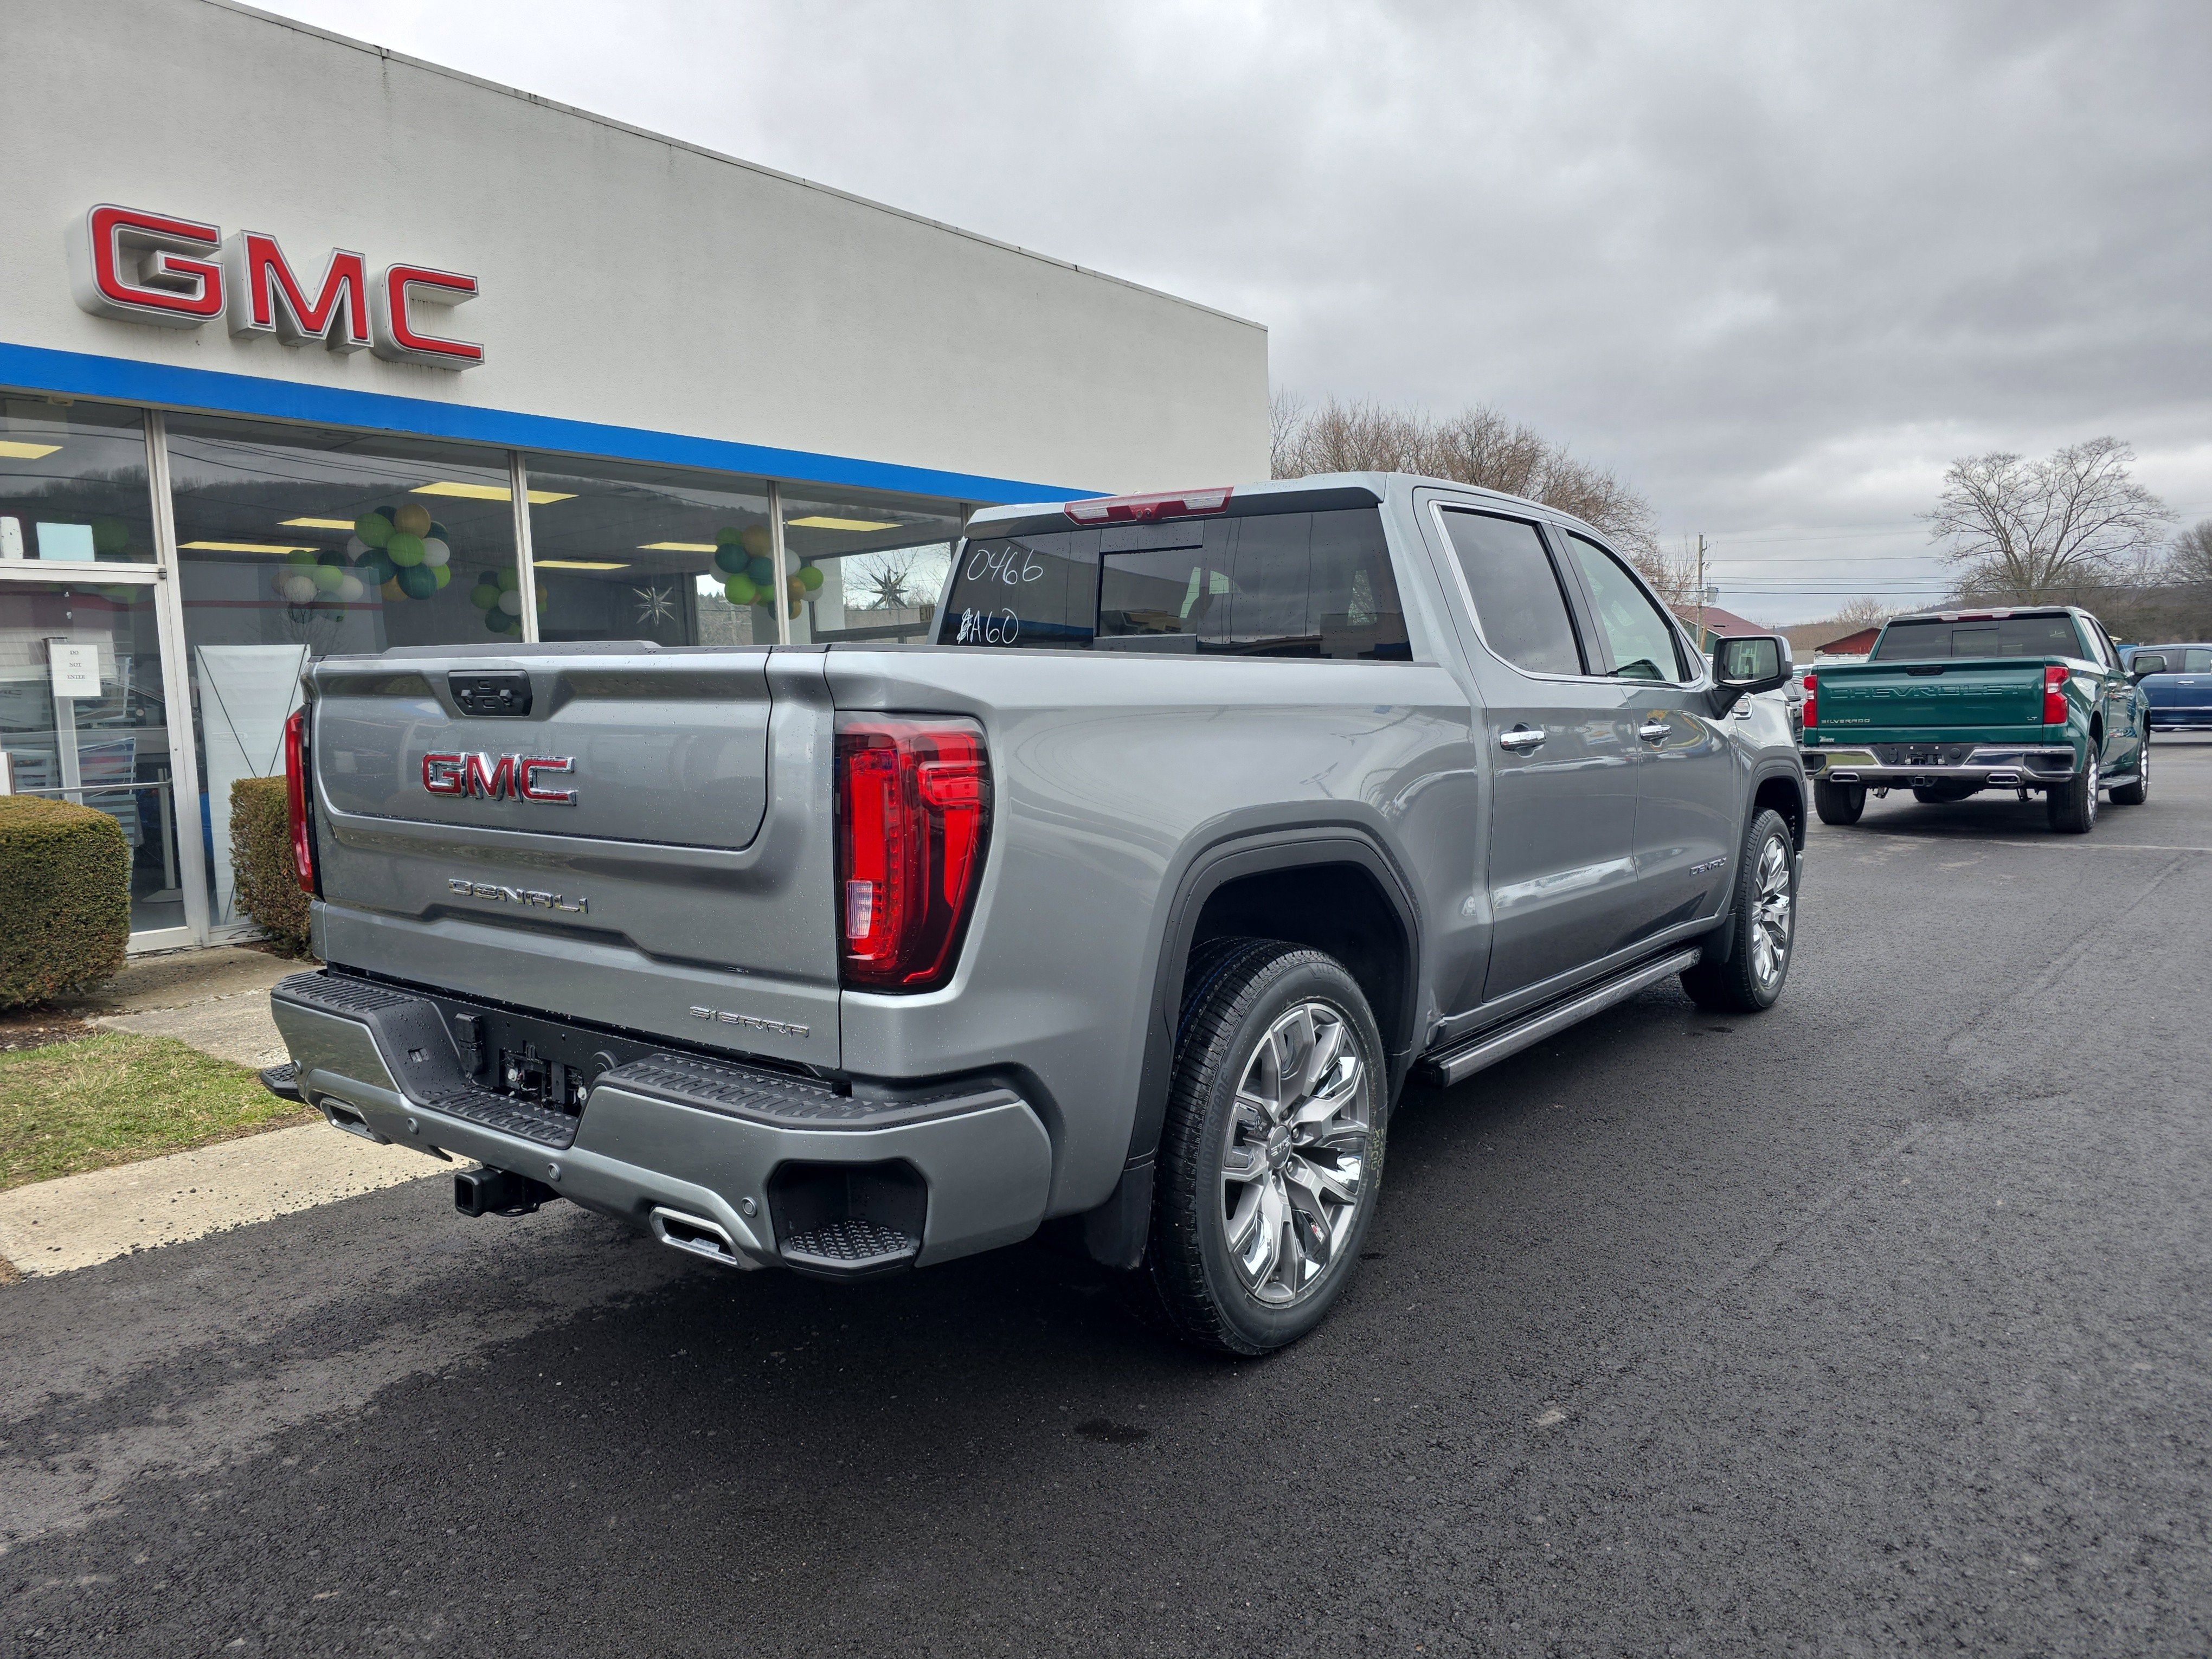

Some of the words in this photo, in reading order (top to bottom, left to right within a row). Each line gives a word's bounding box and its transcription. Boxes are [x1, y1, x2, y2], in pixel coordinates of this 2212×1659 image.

[86, 203, 485, 366] GMC
[967, 546, 1043, 584] 0466
[1830, 684, 2027, 698] CHEVROLET
[422, 750, 578, 806] GMC
[1689, 857, 1727, 877] DENALI
[448, 878, 588, 914] DENALI
[690, 1006, 809, 1038] SIERRA
